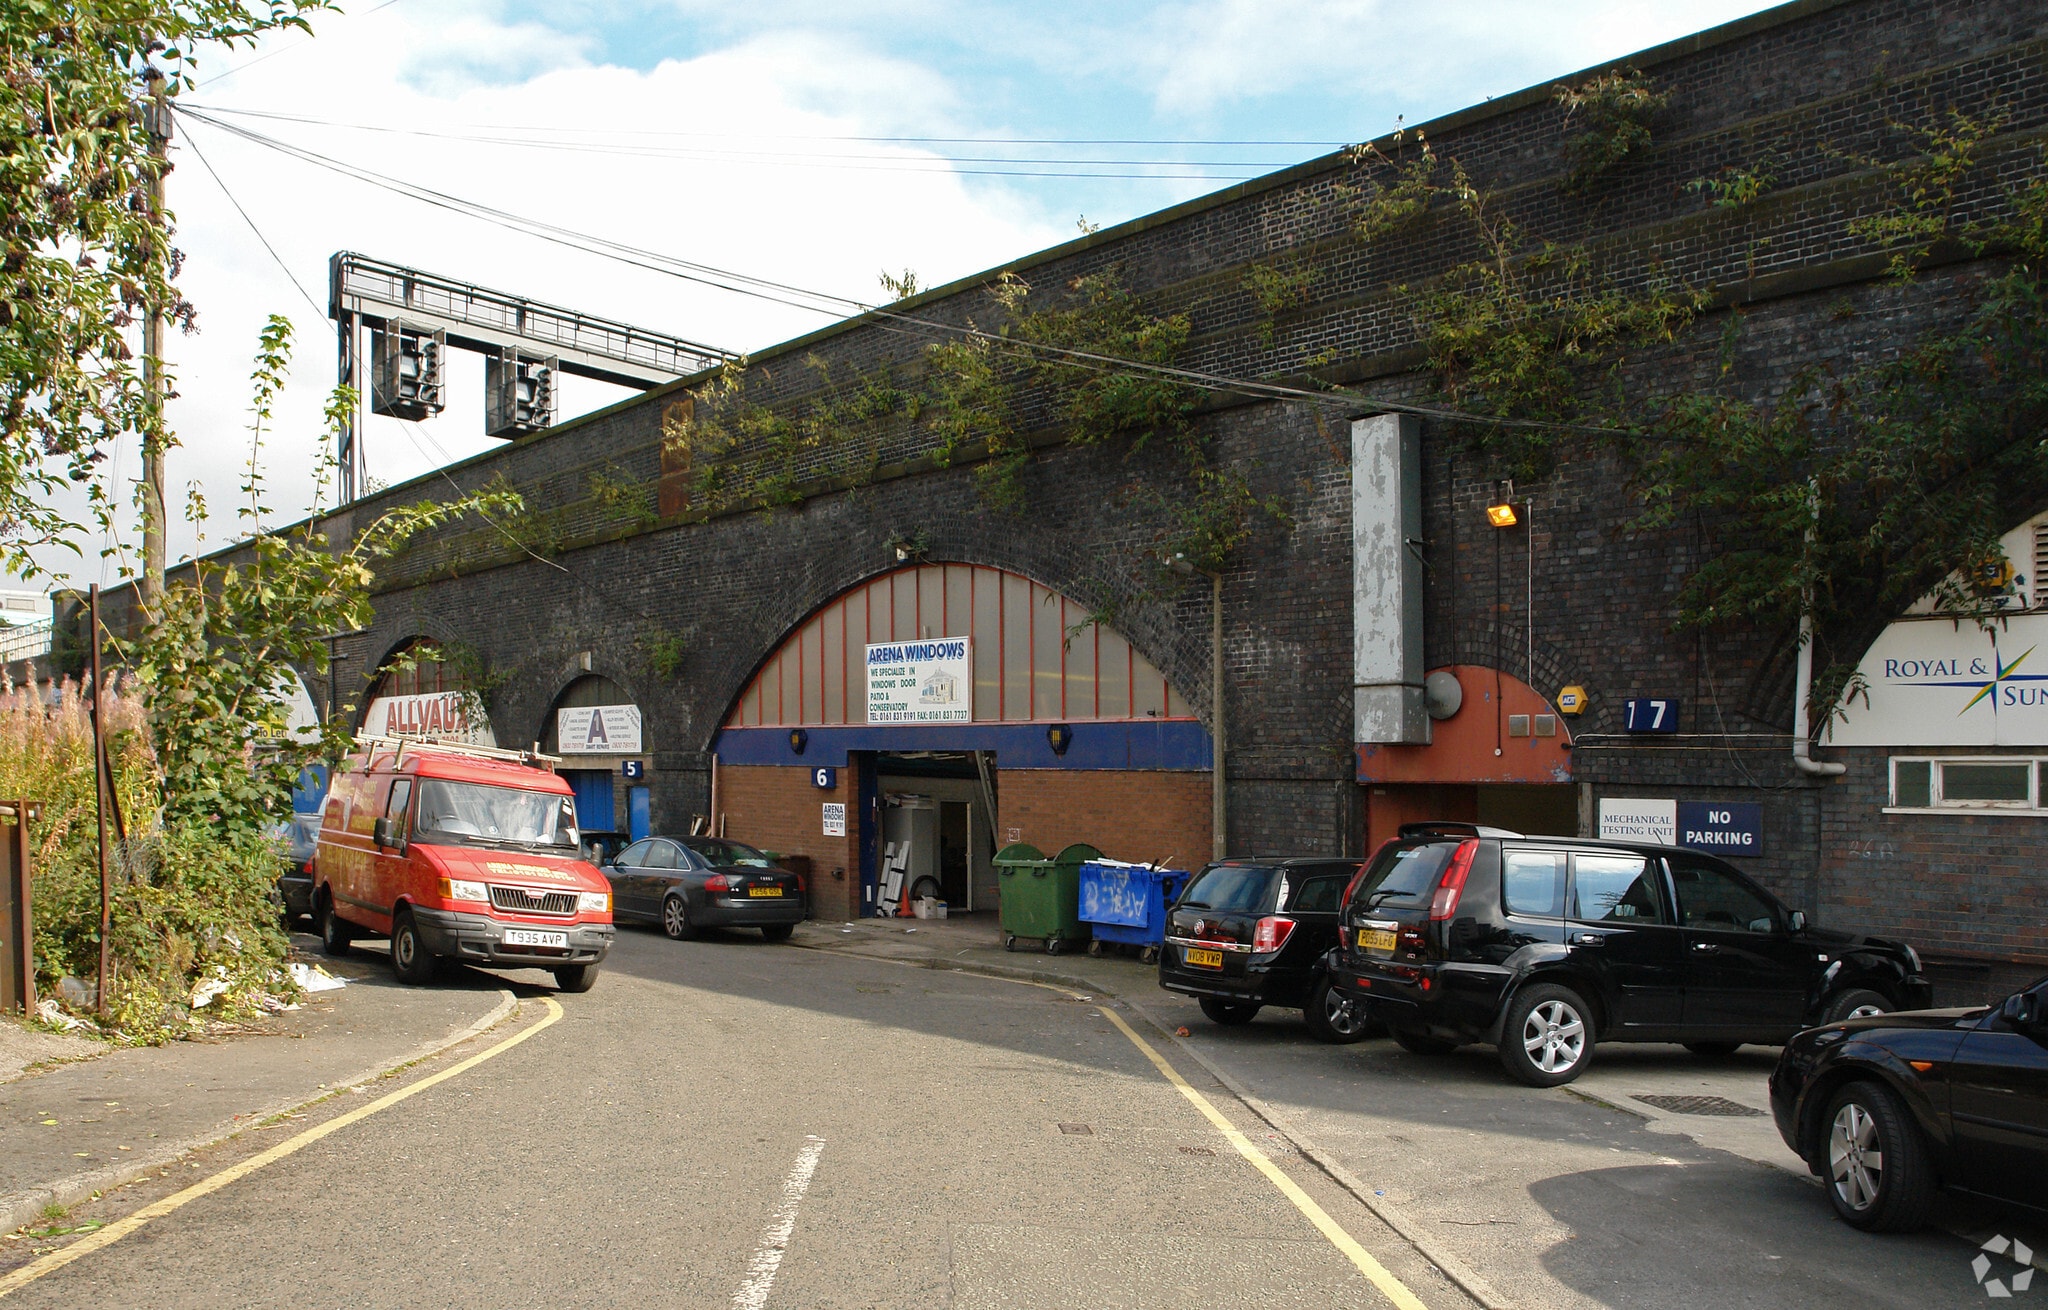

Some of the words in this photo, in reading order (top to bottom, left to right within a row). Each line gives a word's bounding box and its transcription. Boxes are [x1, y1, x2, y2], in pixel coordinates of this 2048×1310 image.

[867, 645, 904, 664] ARENA
[904, 641, 965, 661] WINDOWS
[871, 667, 878, 677] WE
[879, 667, 905, 677] SPECIALIZE
[909, 666, 916, 675] IN
[1884, 659, 1962, 678] ROYAL
[1969, 657, 1989, 675] &
[871, 680, 896, 689] WINDOWS
[900, 678, 916, 688] DOOR
[870, 692, 885, 701] PATIO
[885, 692, 889, 700] &
[869, 703, 909, 712] CONSERVATORY
[869, 712, 879, 721] TEL:
[880, 712, 892, 721] 0161
[893, 712, 902, 720] 831
[903, 711, 916, 720] 9191
[917, 711, 928, 720] FAX:
[929, 711, 941, 720] 0161
[943, 711, 952, 720] 831
[954, 710, 967, 719] 7737
[627, 761, 636, 777] 5
[816, 768, 828, 787] 6
[824, 804, 844, 814] ARENA
[1604, 814, 1672, 825] MECHANICAL
[1709, 811, 1731, 824] NO
[1601, 826, 1644, 836] TESTING
[1648, 826, 1674, 837] UNIT
[1686, 830, 1753, 846] PARKING
[510, 931, 539, 943] T935
[541, 933, 562, 945] AVP
